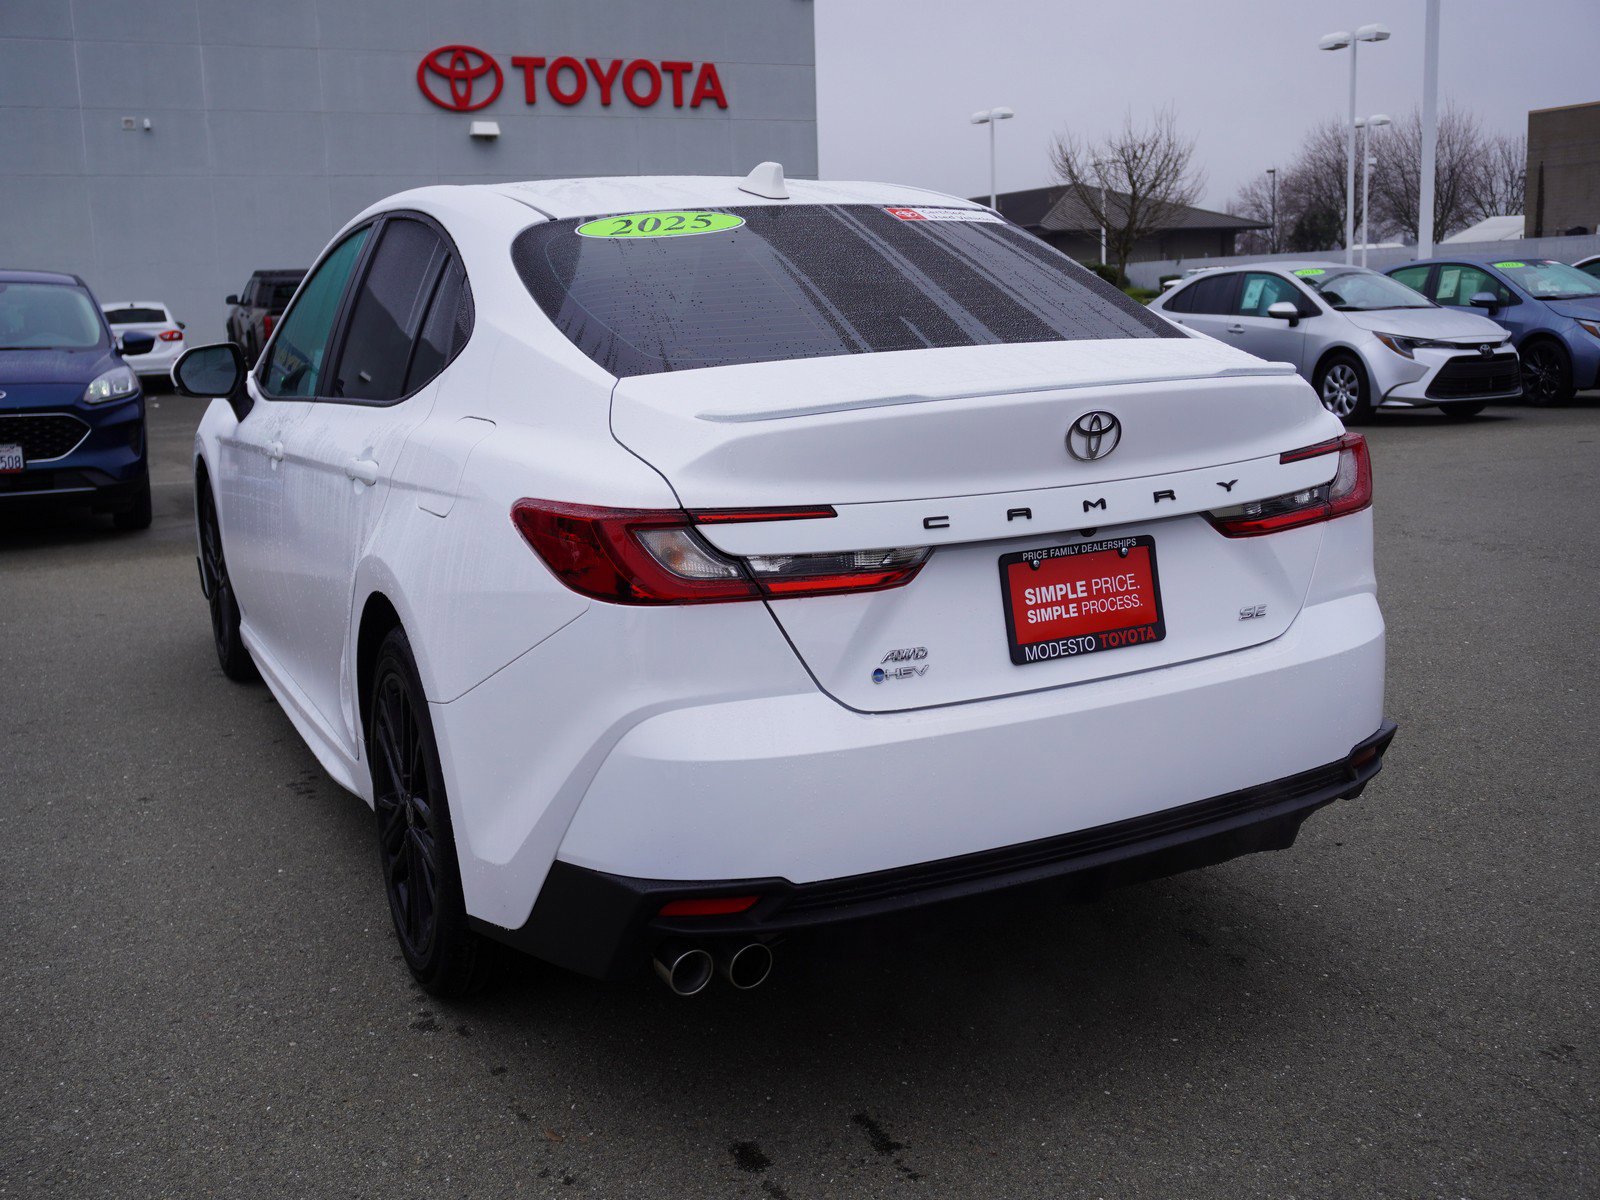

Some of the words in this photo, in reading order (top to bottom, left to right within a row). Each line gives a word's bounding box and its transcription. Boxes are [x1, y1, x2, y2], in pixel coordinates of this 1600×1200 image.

[511, 56, 728, 109] TOYOTA
[610, 214, 713, 236] 2025
[923, 479, 1239, 529] CAMRY
[1023, 551, 1047, 561] PRICE
[1050, 546, 1079, 557] FAMILY
[1082, 538, 1137, 553] DEALERSHIPS
[1025, 580, 1088, 606] SIMPLE
[1092, 573, 1141, 596] PRICE.
[1027, 603, 1079, 624] SIMPLE
[1082, 594, 1143, 615] PROCESS.
[1239, 604, 1267, 621] SE
[881, 646, 928, 664] AWD
[1025, 636, 1096, 661] MODESTO
[1099, 626, 1157, 648] TOYOTA
